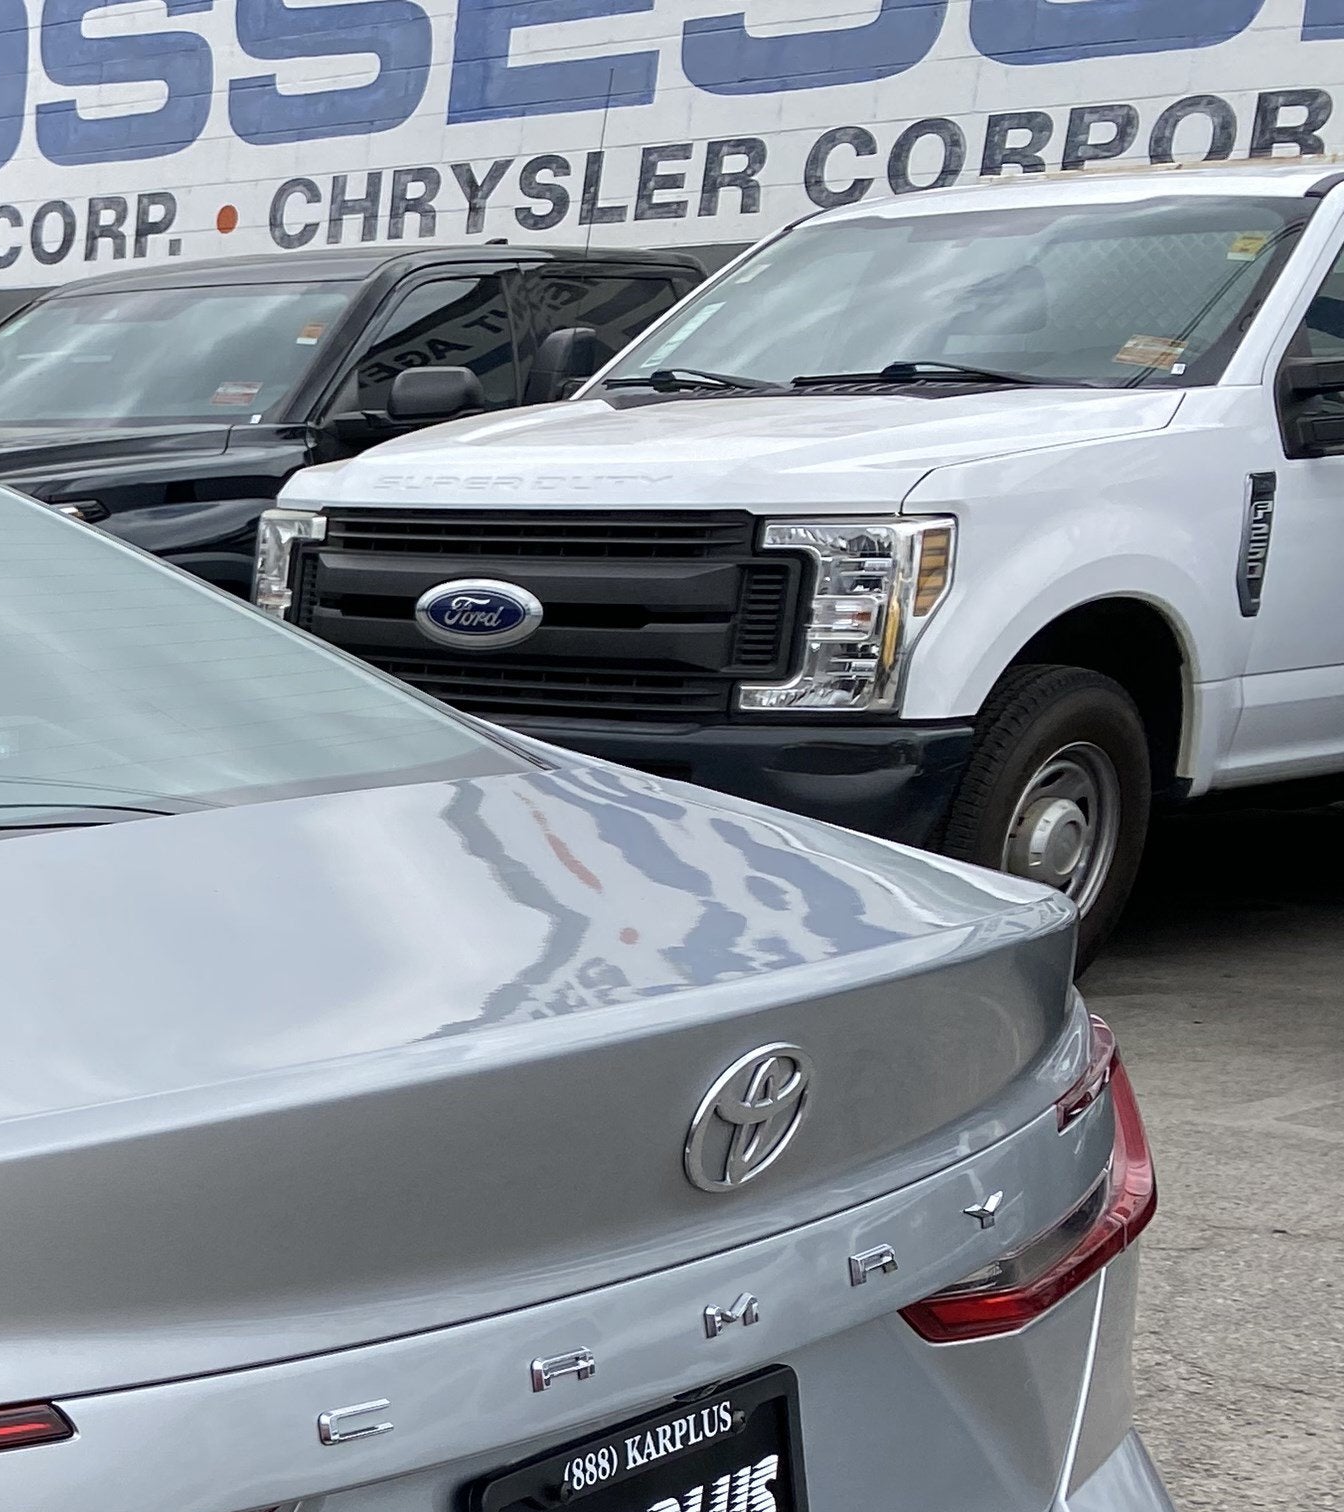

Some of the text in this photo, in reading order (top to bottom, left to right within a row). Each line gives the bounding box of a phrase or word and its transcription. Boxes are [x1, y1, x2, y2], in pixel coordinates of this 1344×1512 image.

[269, 136, 768, 250] CHRYSLER
[374, 474, 674, 491] SUPER DUTY
[444, 596, 505, 629] Ford
[317, 1190, 1004, 1447] CAMRY
[563, 1400, 733, 1492] (888) KARPLUS
